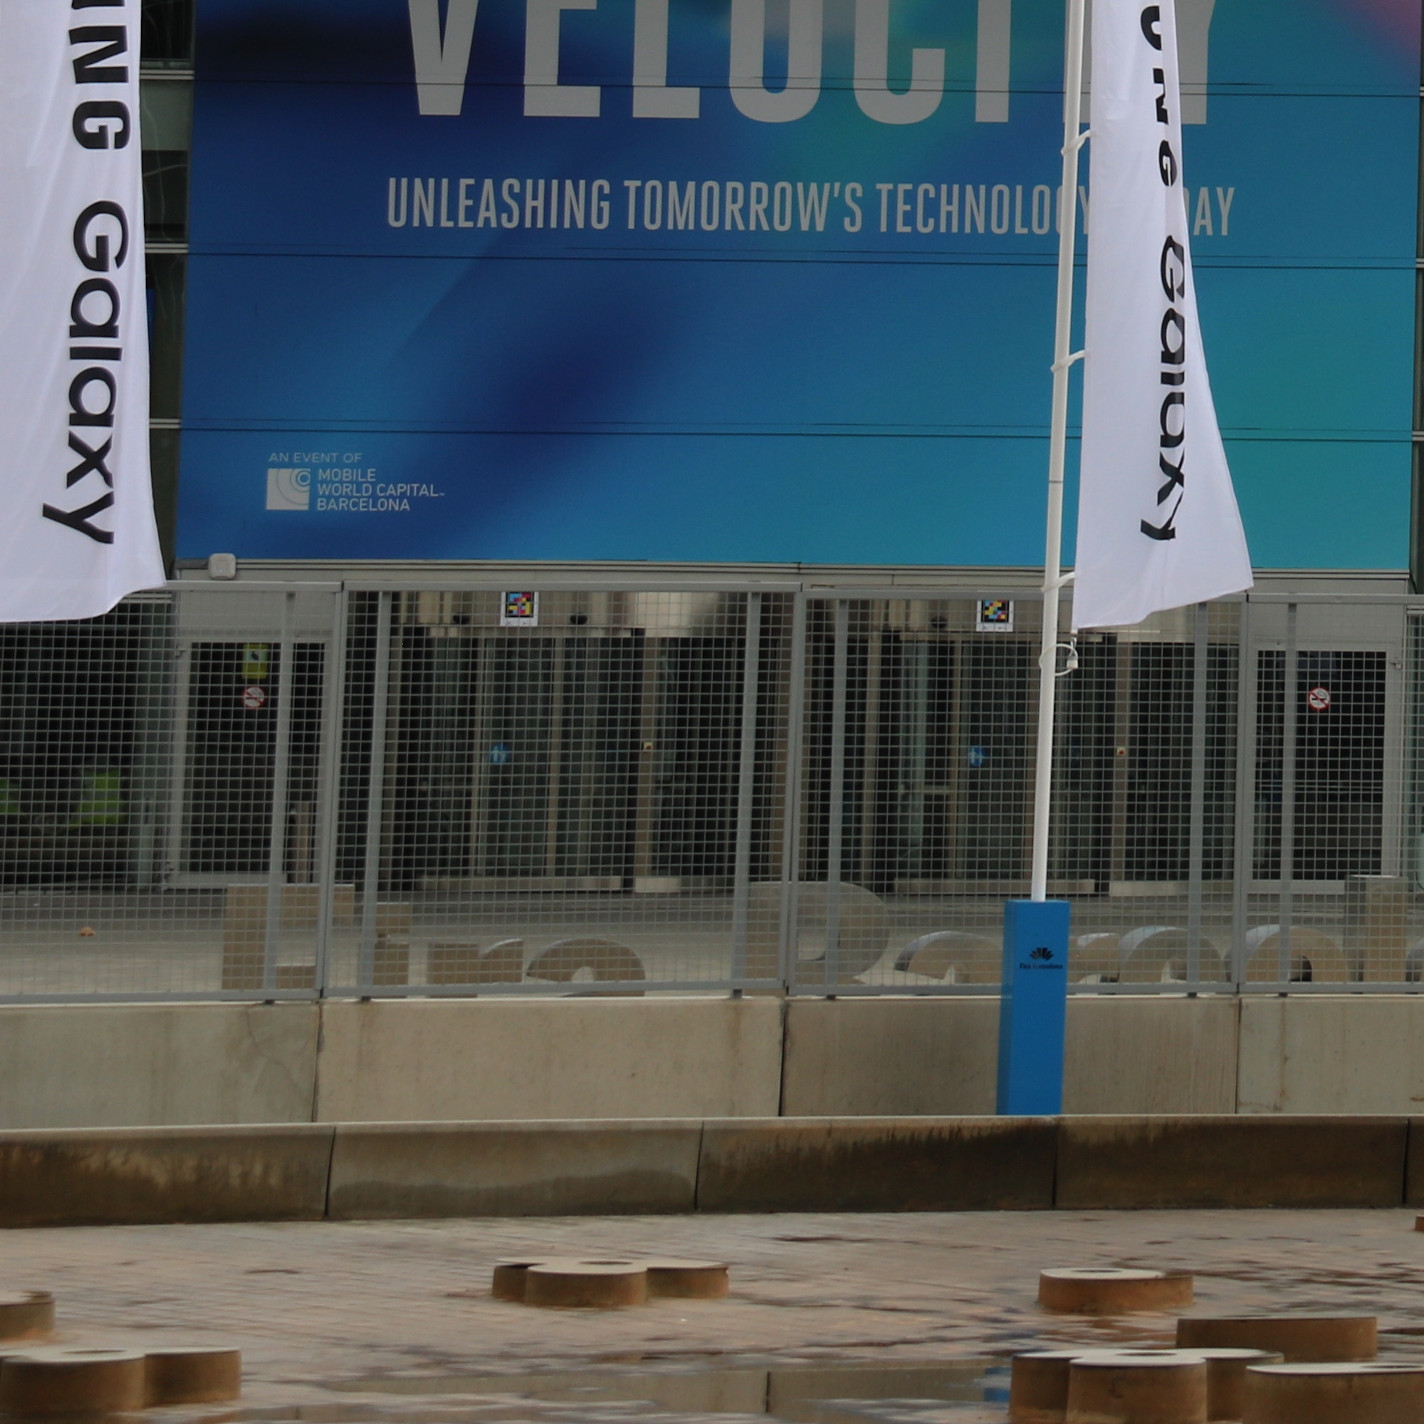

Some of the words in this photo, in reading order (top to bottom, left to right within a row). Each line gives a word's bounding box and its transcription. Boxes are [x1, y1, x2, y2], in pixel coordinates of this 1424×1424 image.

[388, 176, 611, 230] UNLEASHING
[623, 180, 863, 233] TOMORROW'S
[875, 183, 1090, 236] TECHNOLOY
[41, 199, 130, 546] Galaxy
[268, 452, 289, 463] AN
[293, 452, 339, 464] EVENT
[343, 453, 363, 464] OF
[317, 468, 377, 482] MOBILE
[317, 483, 373, 497] WORLD
[376, 484, 440, 498] CAPITAL
[316, 498, 411, 512] BARCELONA
